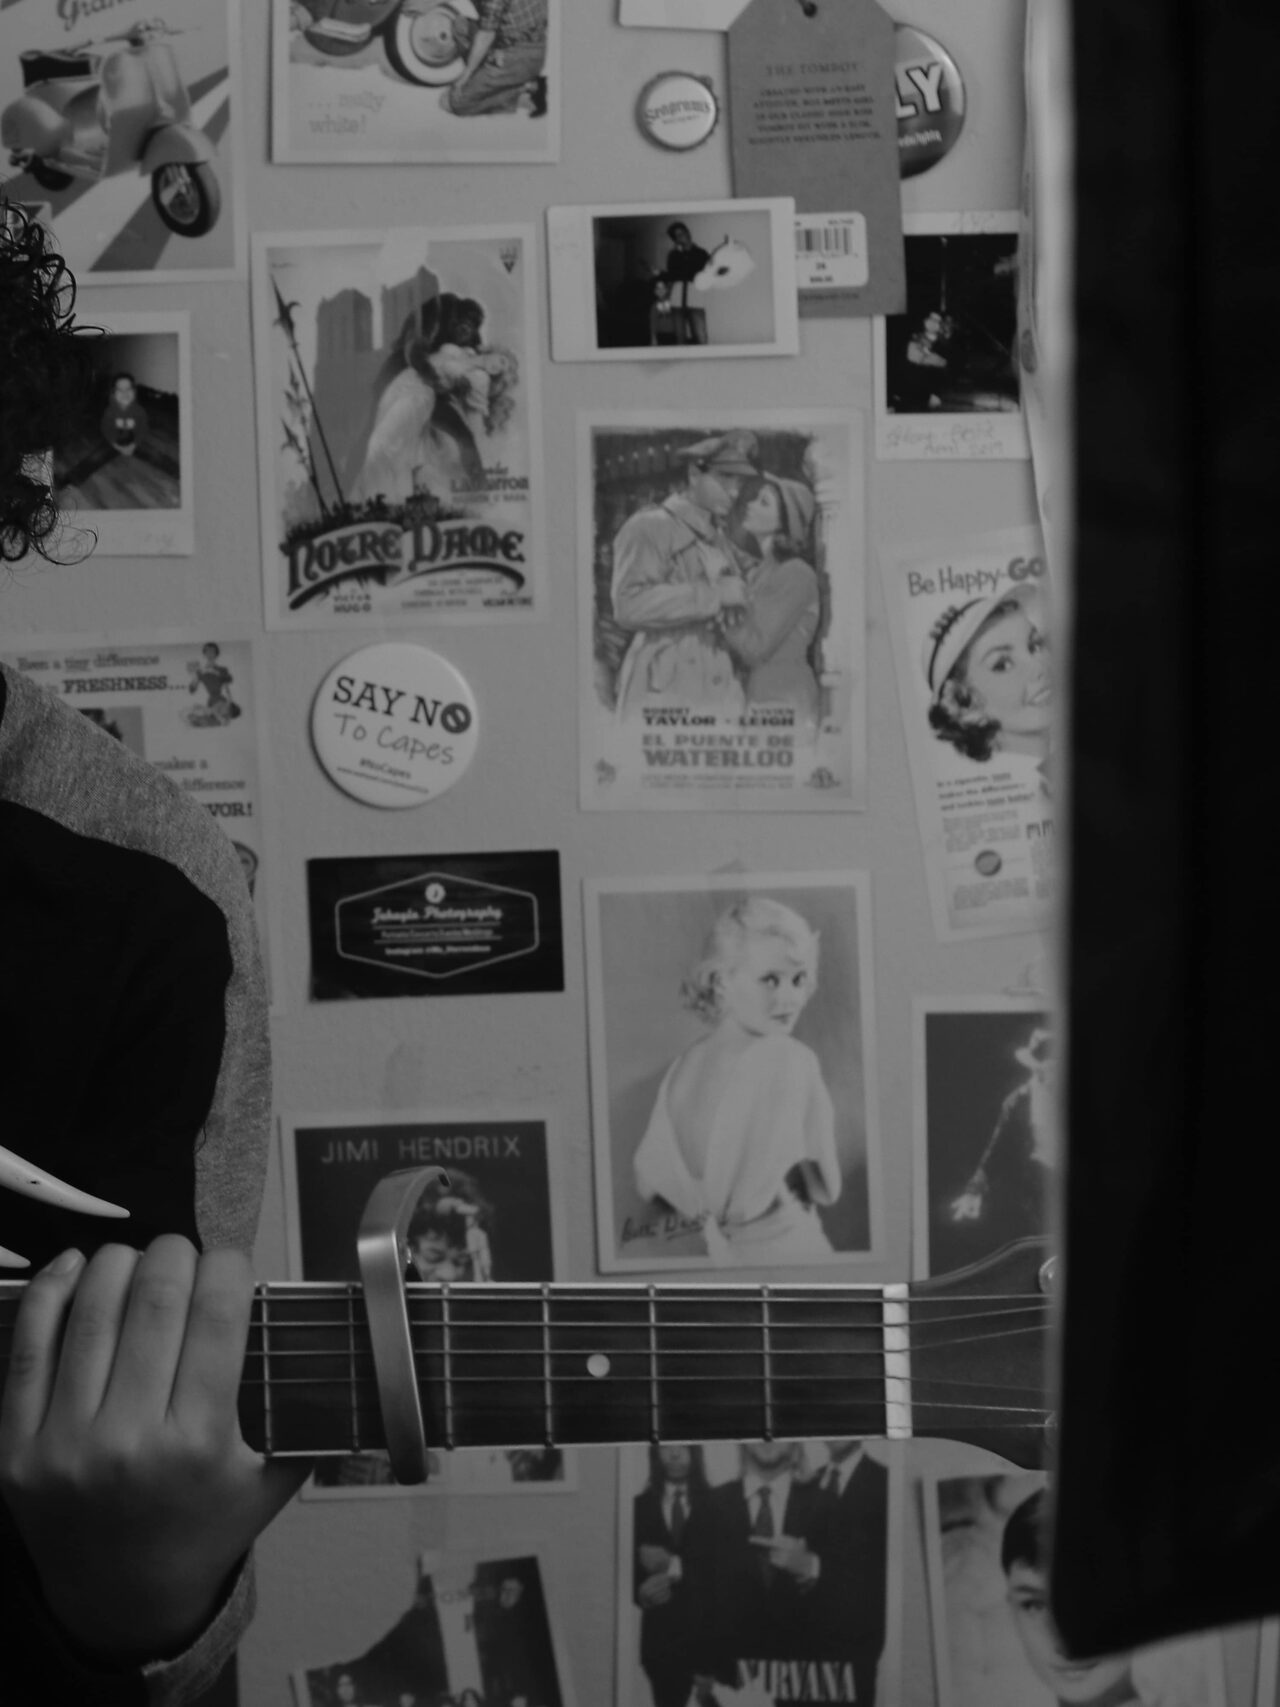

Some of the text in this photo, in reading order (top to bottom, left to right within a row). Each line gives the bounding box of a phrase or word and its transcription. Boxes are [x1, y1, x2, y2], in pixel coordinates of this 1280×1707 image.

[407, 521, 525, 574] DAME
[908, 571, 936, 597] Be
[93, 652, 160, 668] difference
[332, 676, 407, 718] SAY
[643, 715, 796, 727] TAYLOR LEIGH
[333, 713, 456, 766] To Capes
[642, 734, 795, 748] EL PUENTE DE
[642, 748, 795, 768] WATERLOO
[423, 904, 503, 922] Photography
[320, 1134, 521, 1164] JIMI HENDRIX
[736, 1658, 857, 1703] NIRVANA
